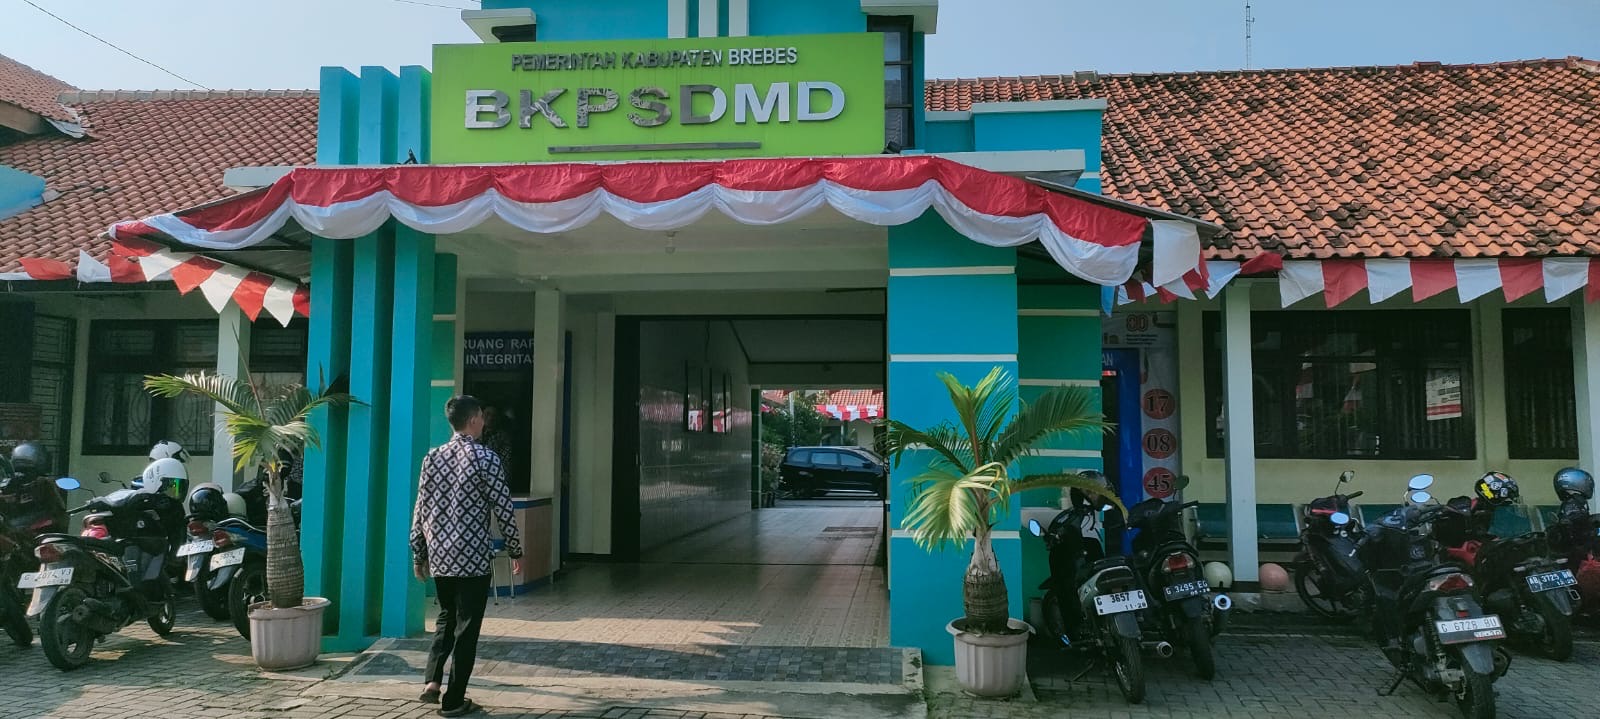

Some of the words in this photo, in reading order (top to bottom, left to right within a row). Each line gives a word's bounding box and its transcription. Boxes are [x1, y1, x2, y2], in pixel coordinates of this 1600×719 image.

[511, 52, 617, 71] PEMERINTAH
[621, 49, 722, 69] KABUPATEN
[728, 47, 797, 66] BREBES
[464, 81, 846, 130] BKPSDMD
[466, 354, 534, 365] INTEGRITA
[1147, 395, 1169, 412] 17
[1147, 434, 1170, 452] 08
[1148, 474, 1170, 491] 45
[1165, 587, 1171, 595] G
[1174, 582, 1194, 593] 3495
[1197, 580, 1208, 588] EG
[1110, 592, 1129, 603] 3657
